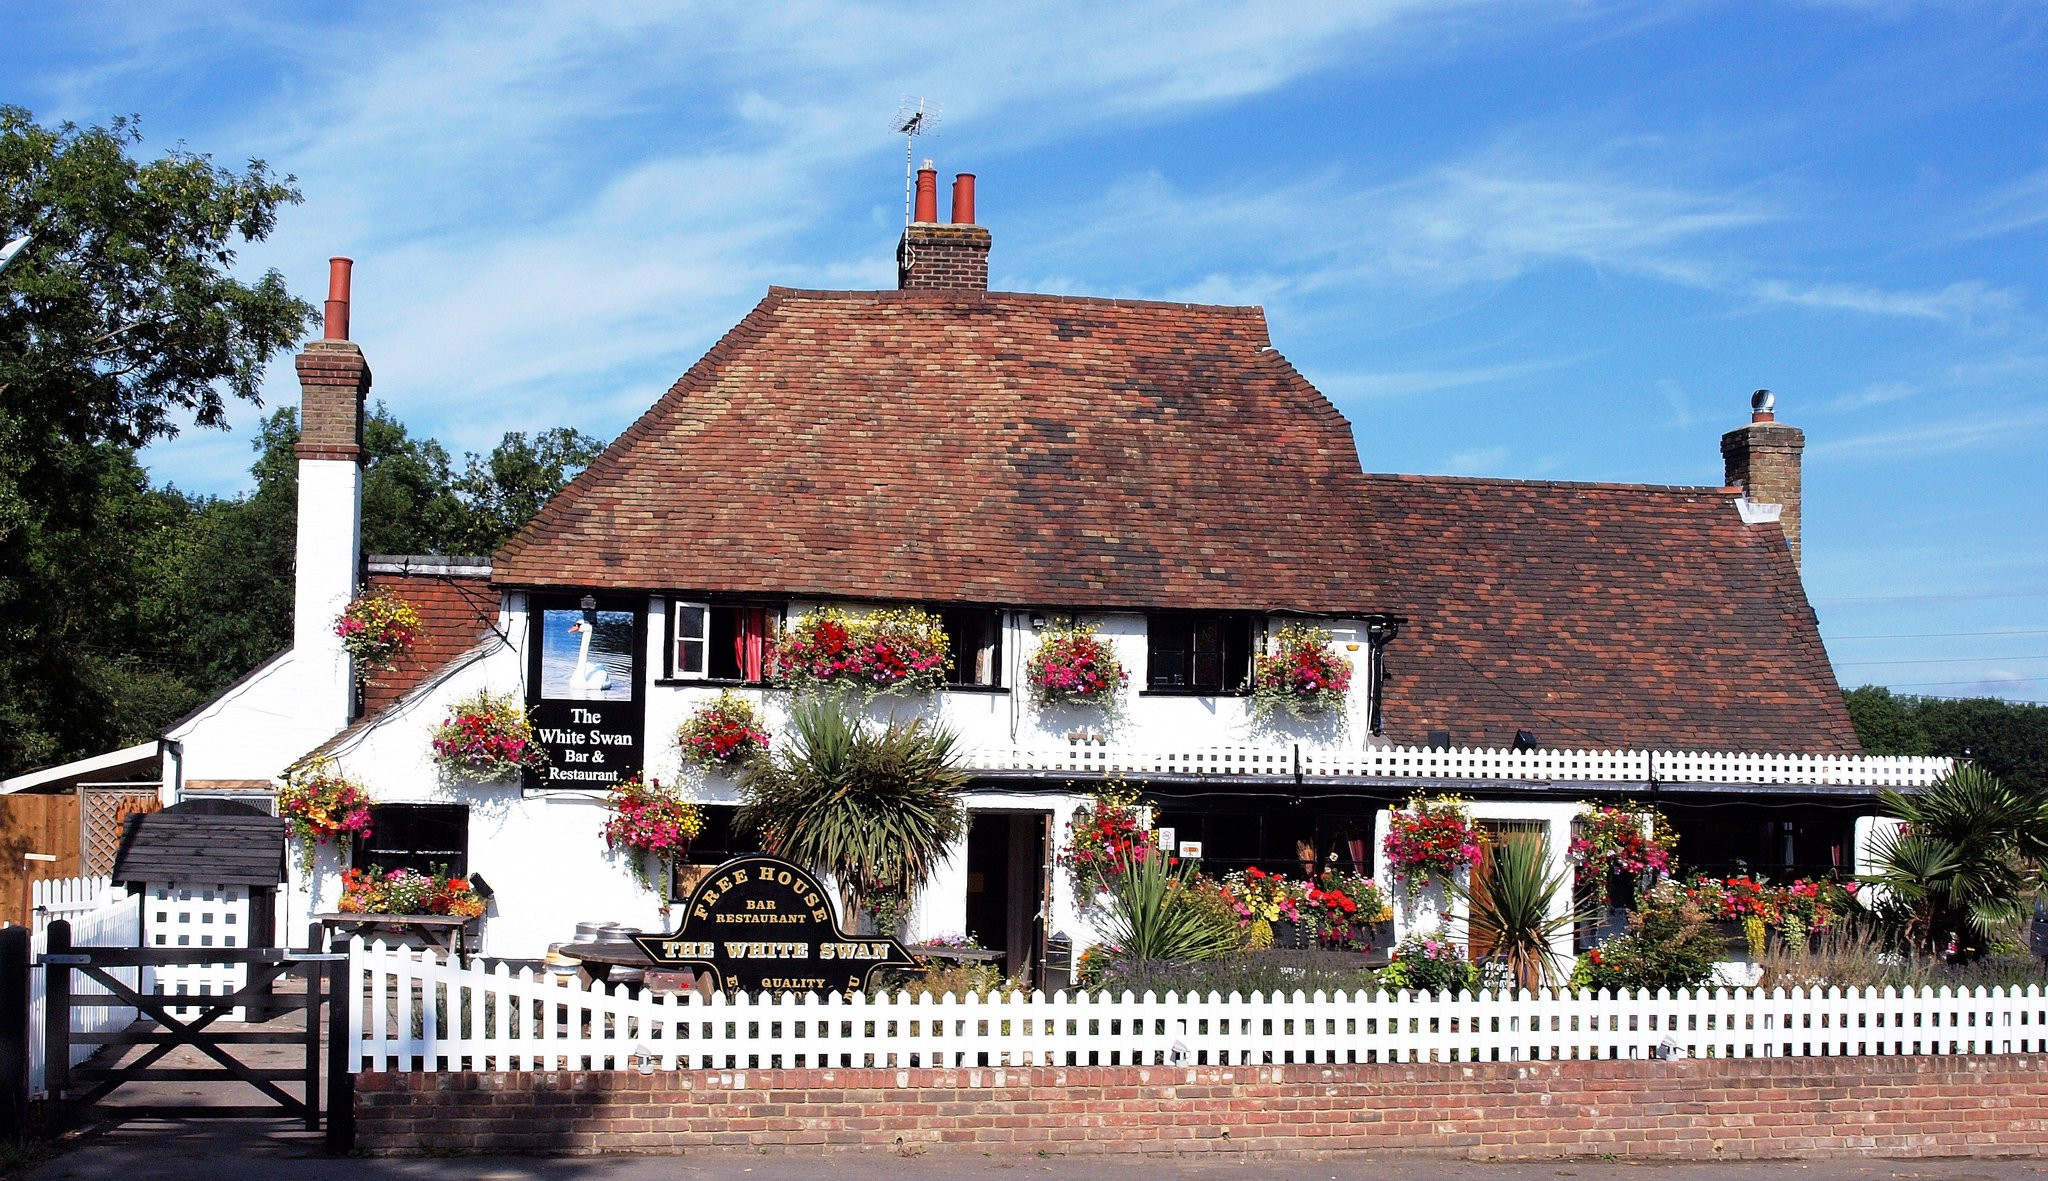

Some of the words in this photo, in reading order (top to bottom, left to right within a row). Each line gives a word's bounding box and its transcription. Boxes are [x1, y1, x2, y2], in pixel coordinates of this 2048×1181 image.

[570, 708, 602, 725] The
[538, 728, 586, 746] White
[589, 730, 633, 746] Swan
[564, 749, 590, 763] Bar
[591, 750, 605, 763] &
[549, 766, 619, 782] Restaurant
[694, 868, 749, 921] FREE
[758, 866, 828, 923] HOUSE
[746, 900, 776, 910] BAR
[715, 914, 807, 924] RESTAURANT
[662, 941, 715, 959] THE
[723, 942, 809, 959] WHITE
[819, 943, 891, 961] SWAN
[761, 978, 826, 989] QUALITY
